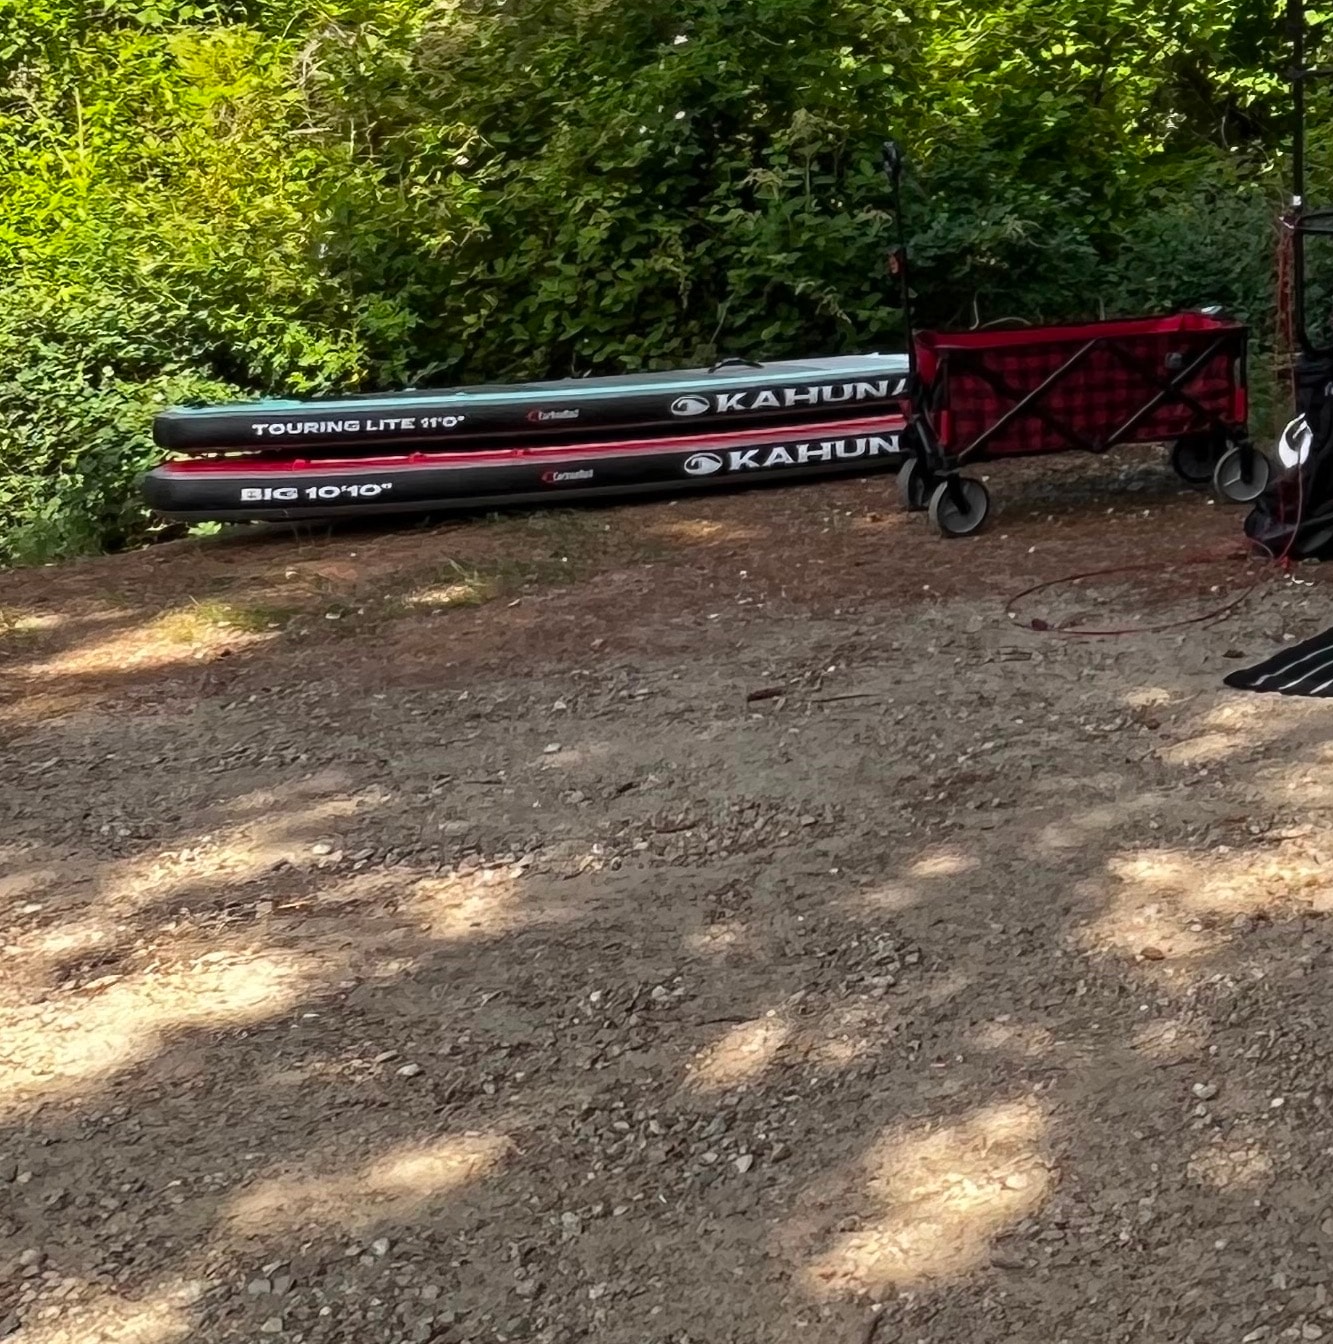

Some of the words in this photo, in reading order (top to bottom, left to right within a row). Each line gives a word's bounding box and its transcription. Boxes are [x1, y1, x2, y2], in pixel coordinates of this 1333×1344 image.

[251, 419, 361, 436] TOURING
[366, 417, 416, 431] LITE
[240, 486, 299, 502] BIG
